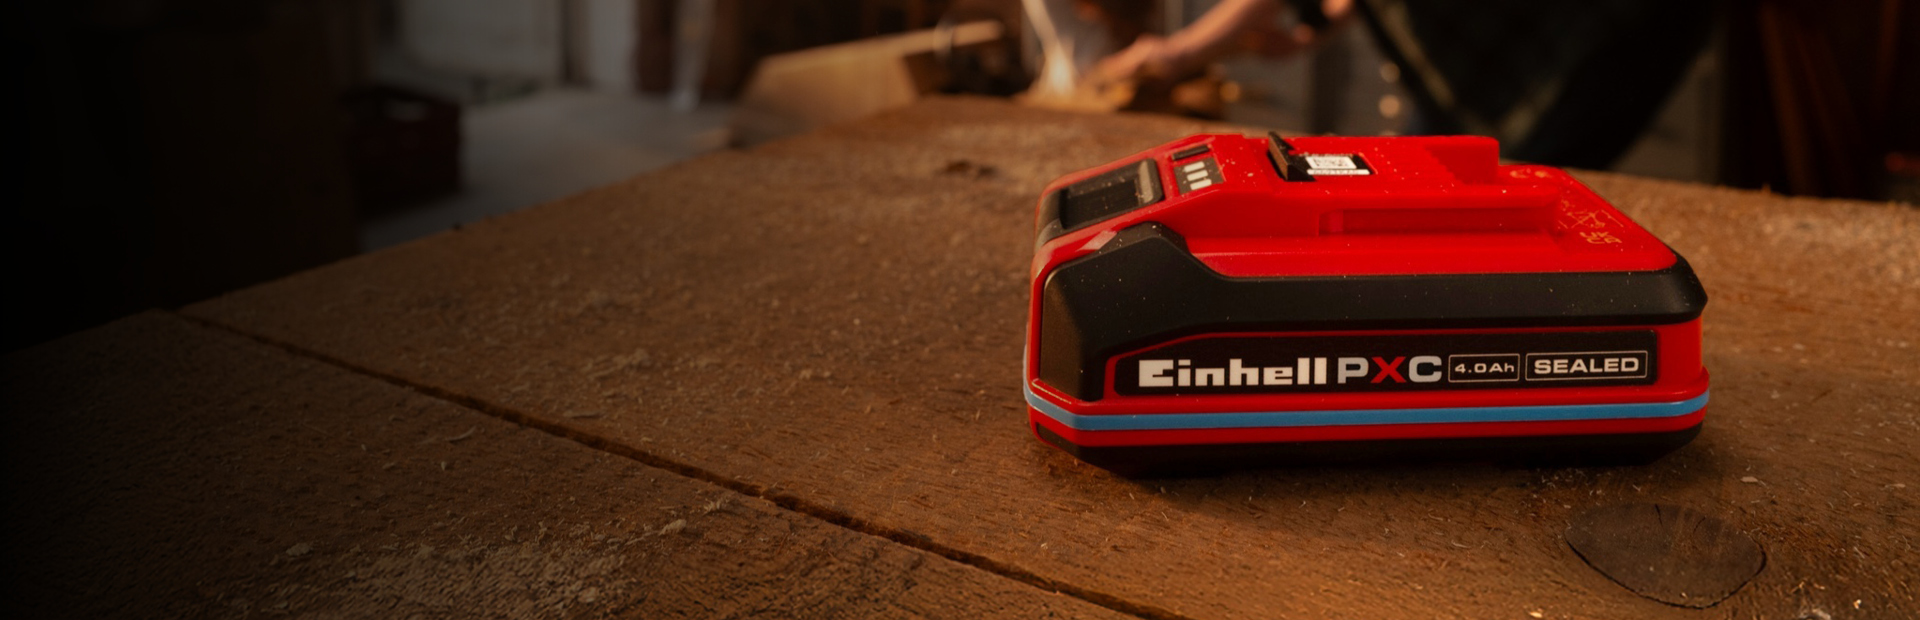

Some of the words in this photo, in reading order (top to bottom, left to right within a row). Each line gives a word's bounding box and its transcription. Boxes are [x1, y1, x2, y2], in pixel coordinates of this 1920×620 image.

[1138, 357, 1327, 387] Einhell
[1337, 356, 1443, 384] PXC
[1454, 362, 1515, 374] 4.0Ah
[1533, 356, 1639, 375] SEALED
